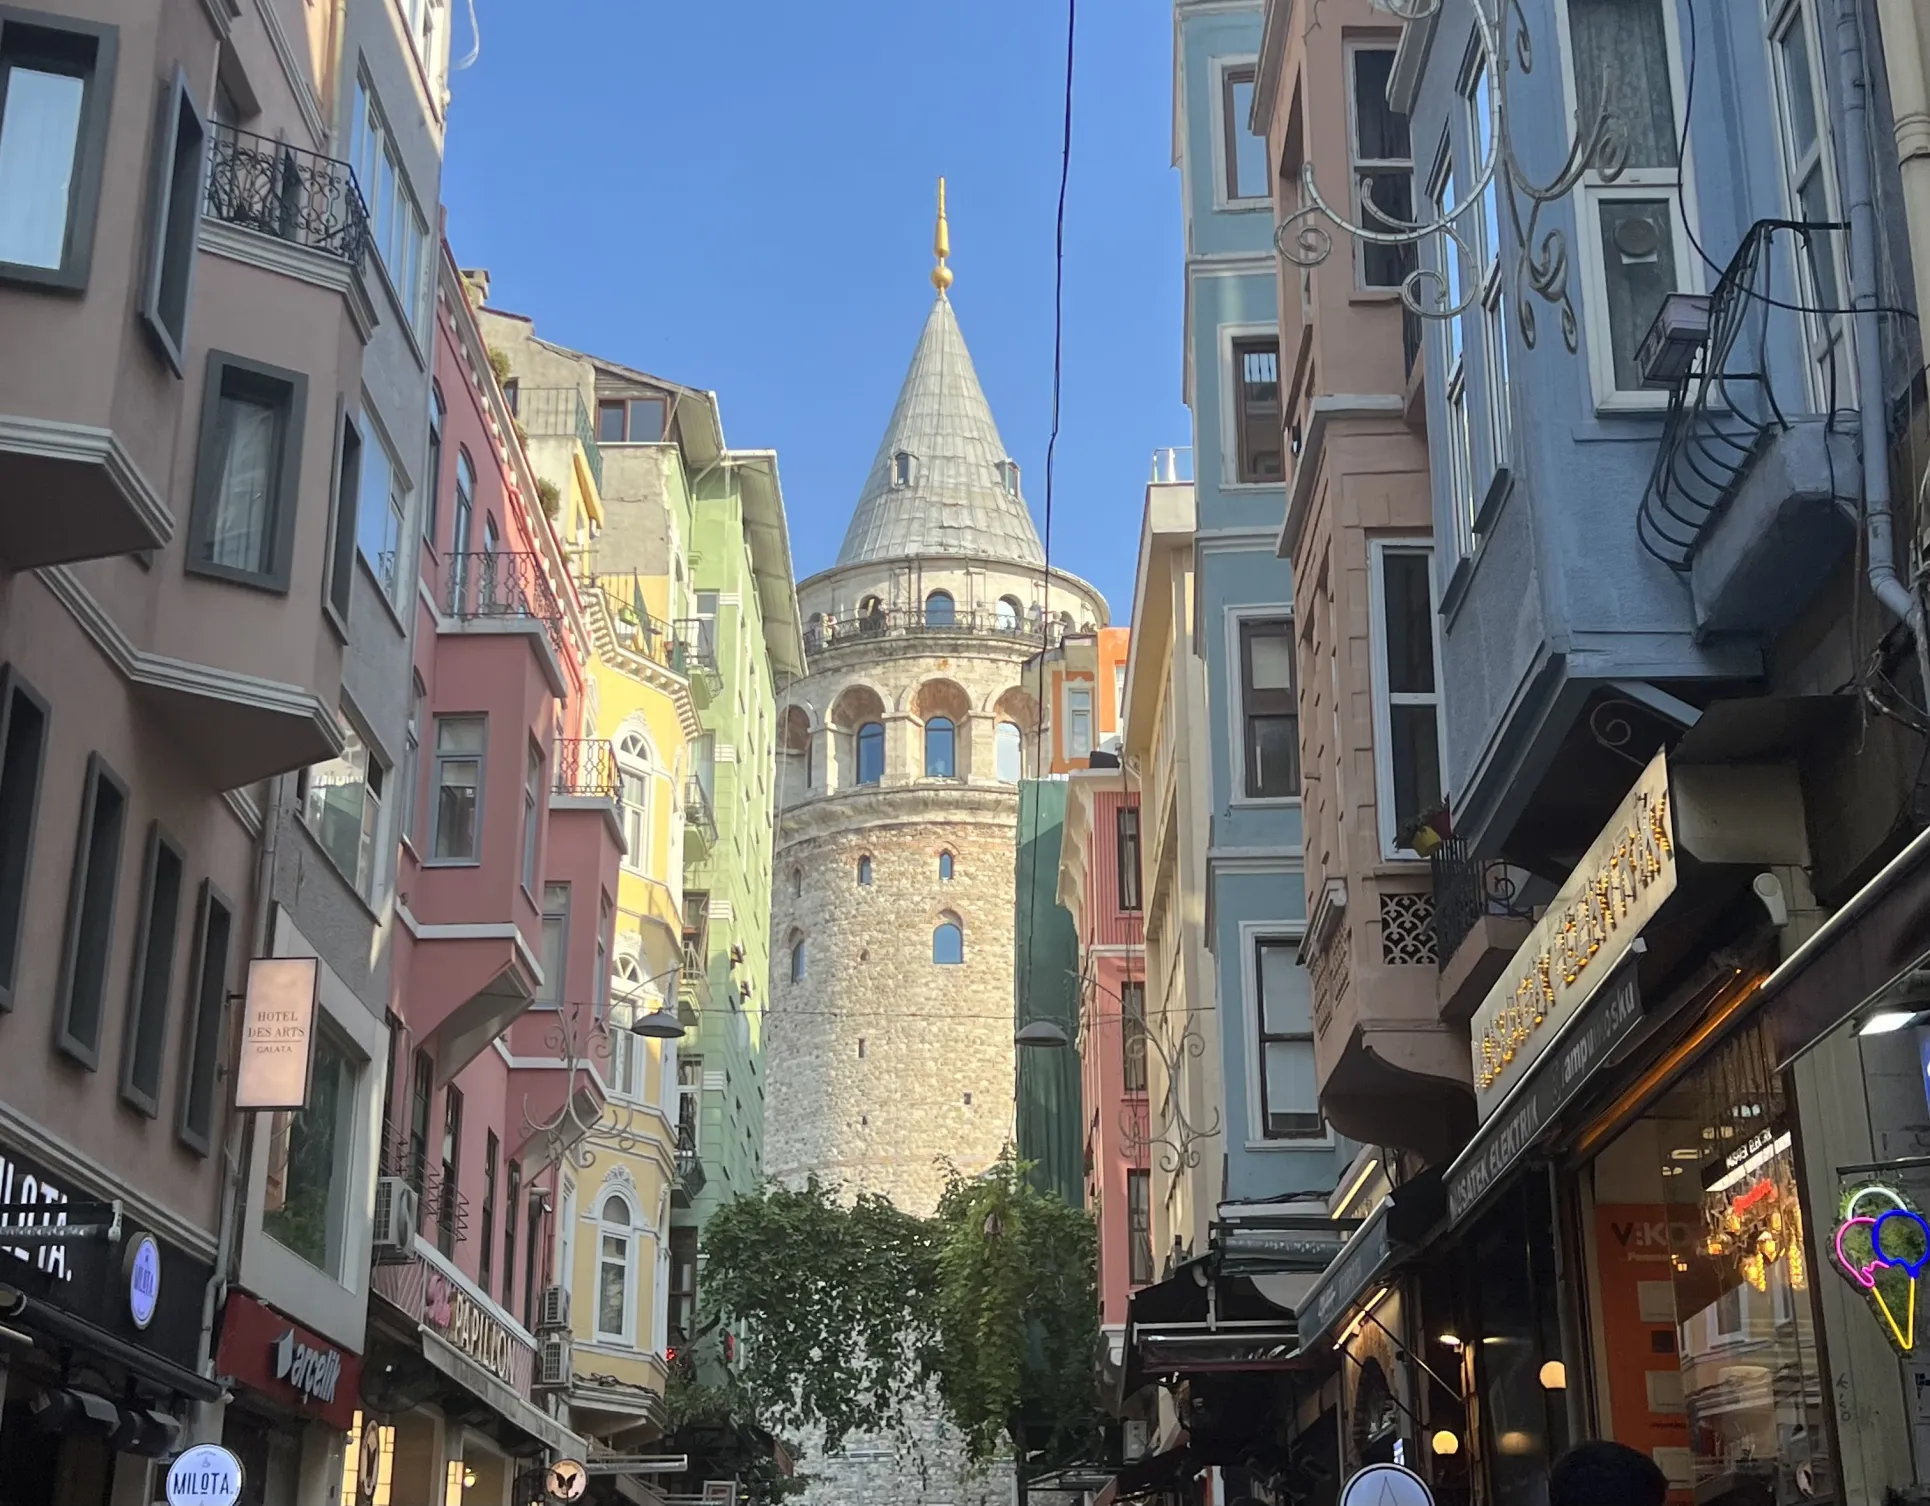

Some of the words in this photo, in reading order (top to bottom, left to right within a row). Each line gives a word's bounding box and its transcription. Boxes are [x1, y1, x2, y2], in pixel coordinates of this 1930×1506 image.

[257, 1010, 299, 1022] HOTEL
[247, 1026, 272, 1038] DES
[274, 1026, 305, 1038] ARTS
[256, 1045, 293, 1054] GALATA
[454, 1292, 516, 1385] PAPILLON
[290, 1342, 342, 1404] arçelik
